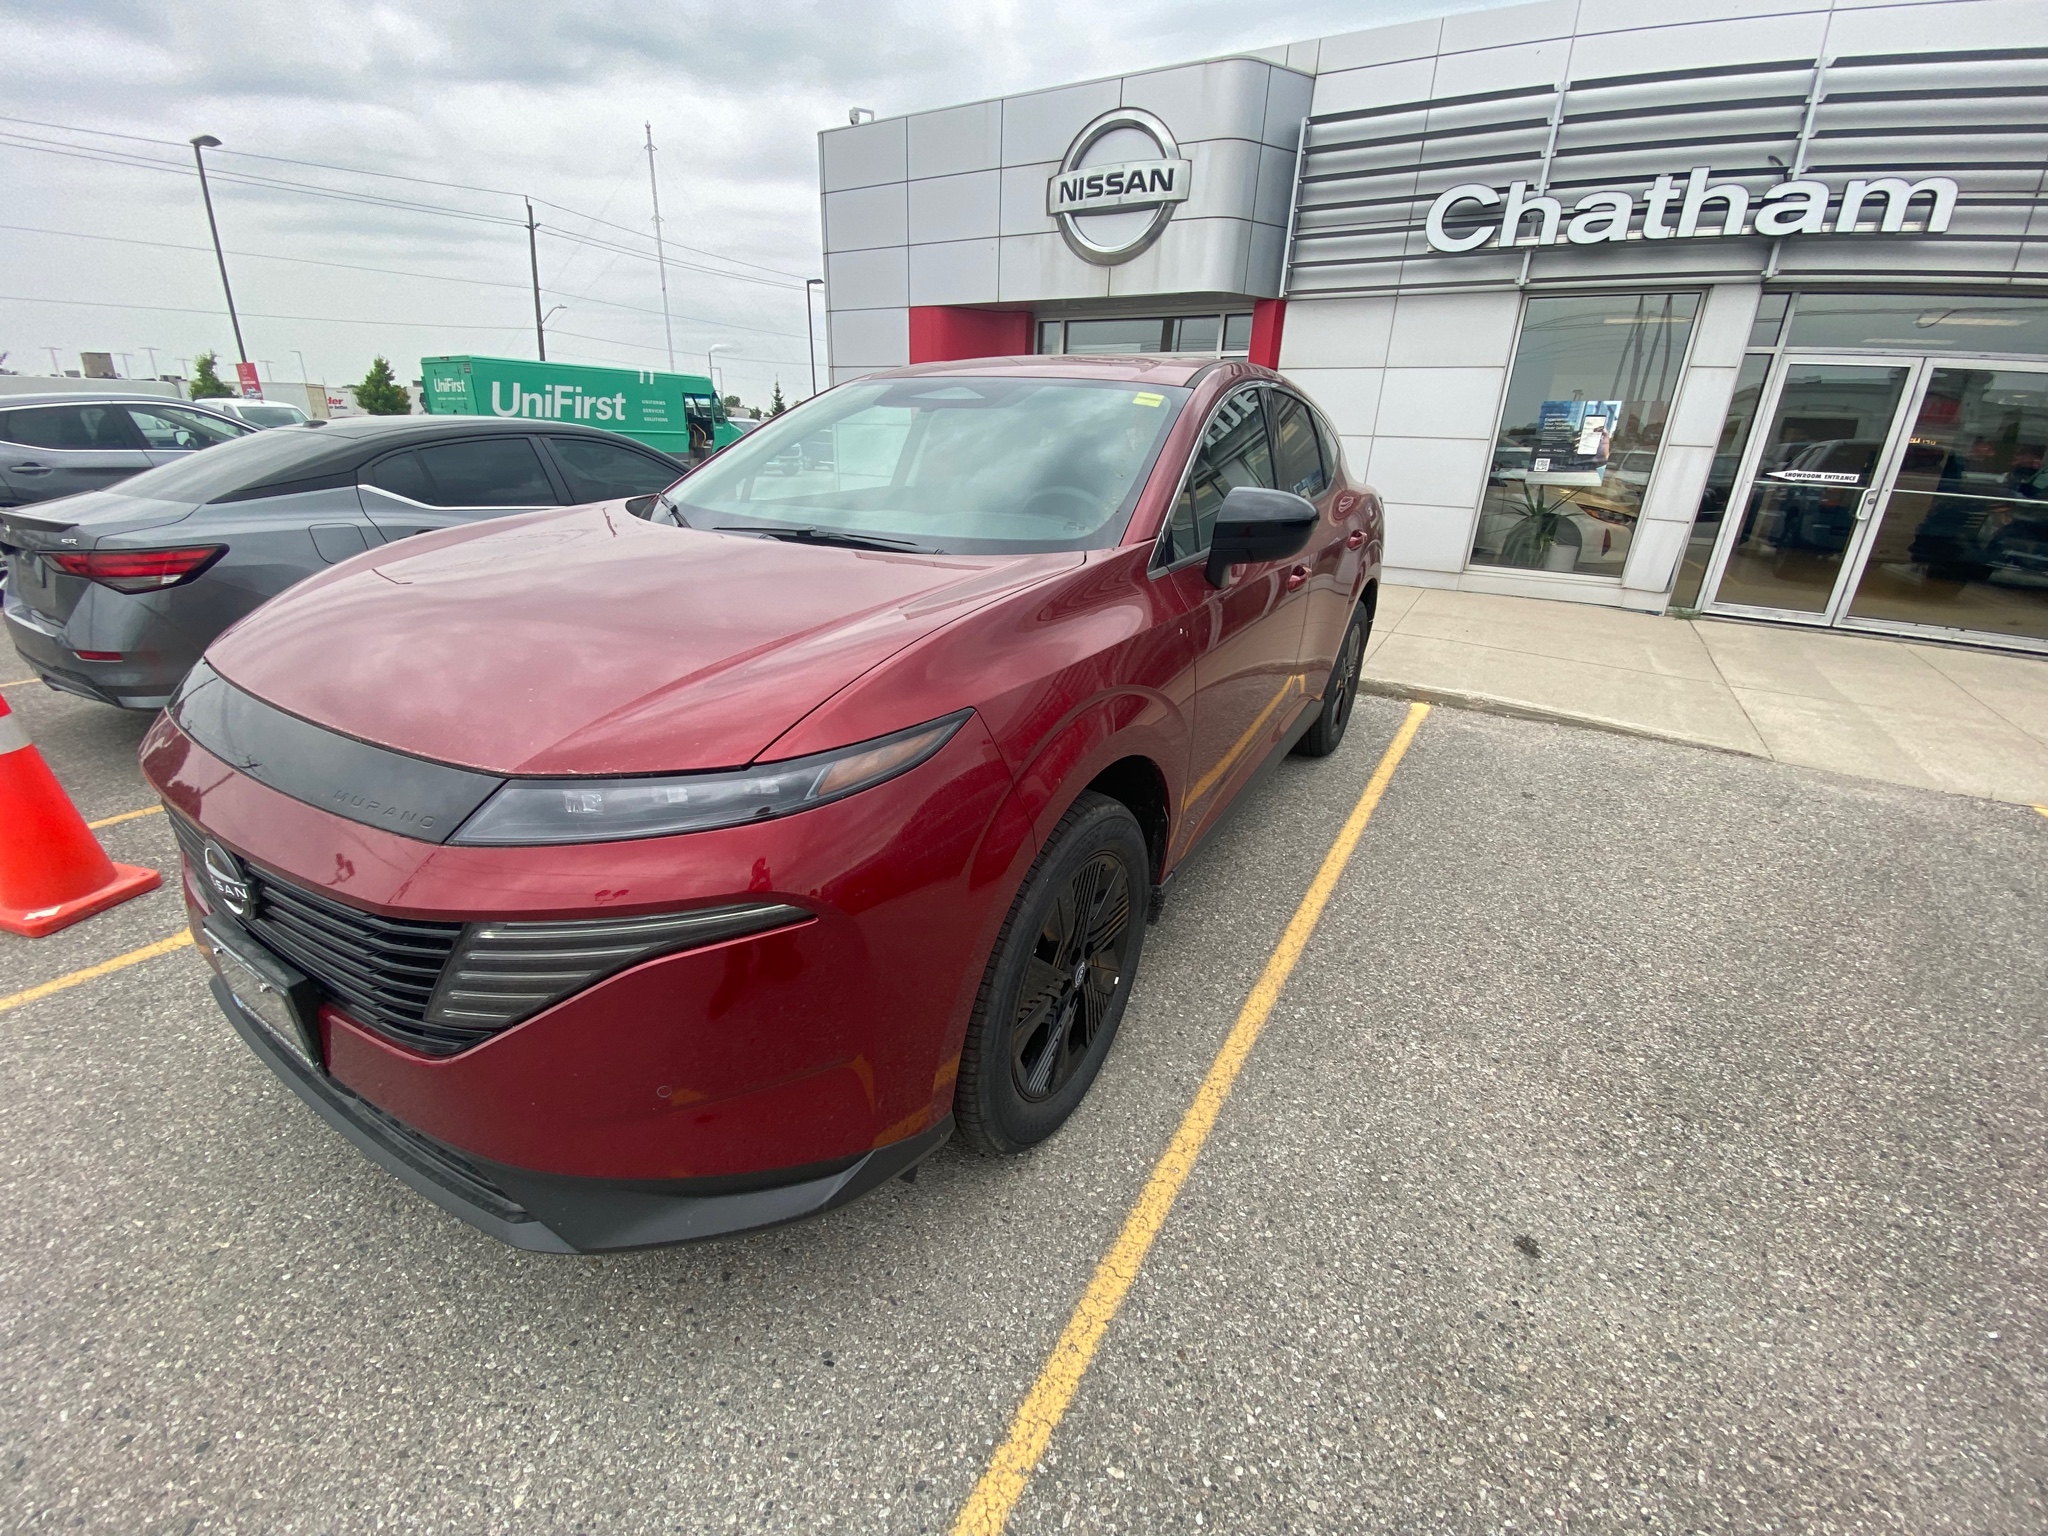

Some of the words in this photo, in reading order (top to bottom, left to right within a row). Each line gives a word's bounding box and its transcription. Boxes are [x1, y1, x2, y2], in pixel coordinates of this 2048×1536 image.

[1059, 168, 1174, 203] NISSAN
[1425, 166, 1960, 252] Chatham
[433, 377, 466, 393] UniFirst
[492, 381, 627, 421] UniFirst
[334, 789, 436, 829] MURANO
